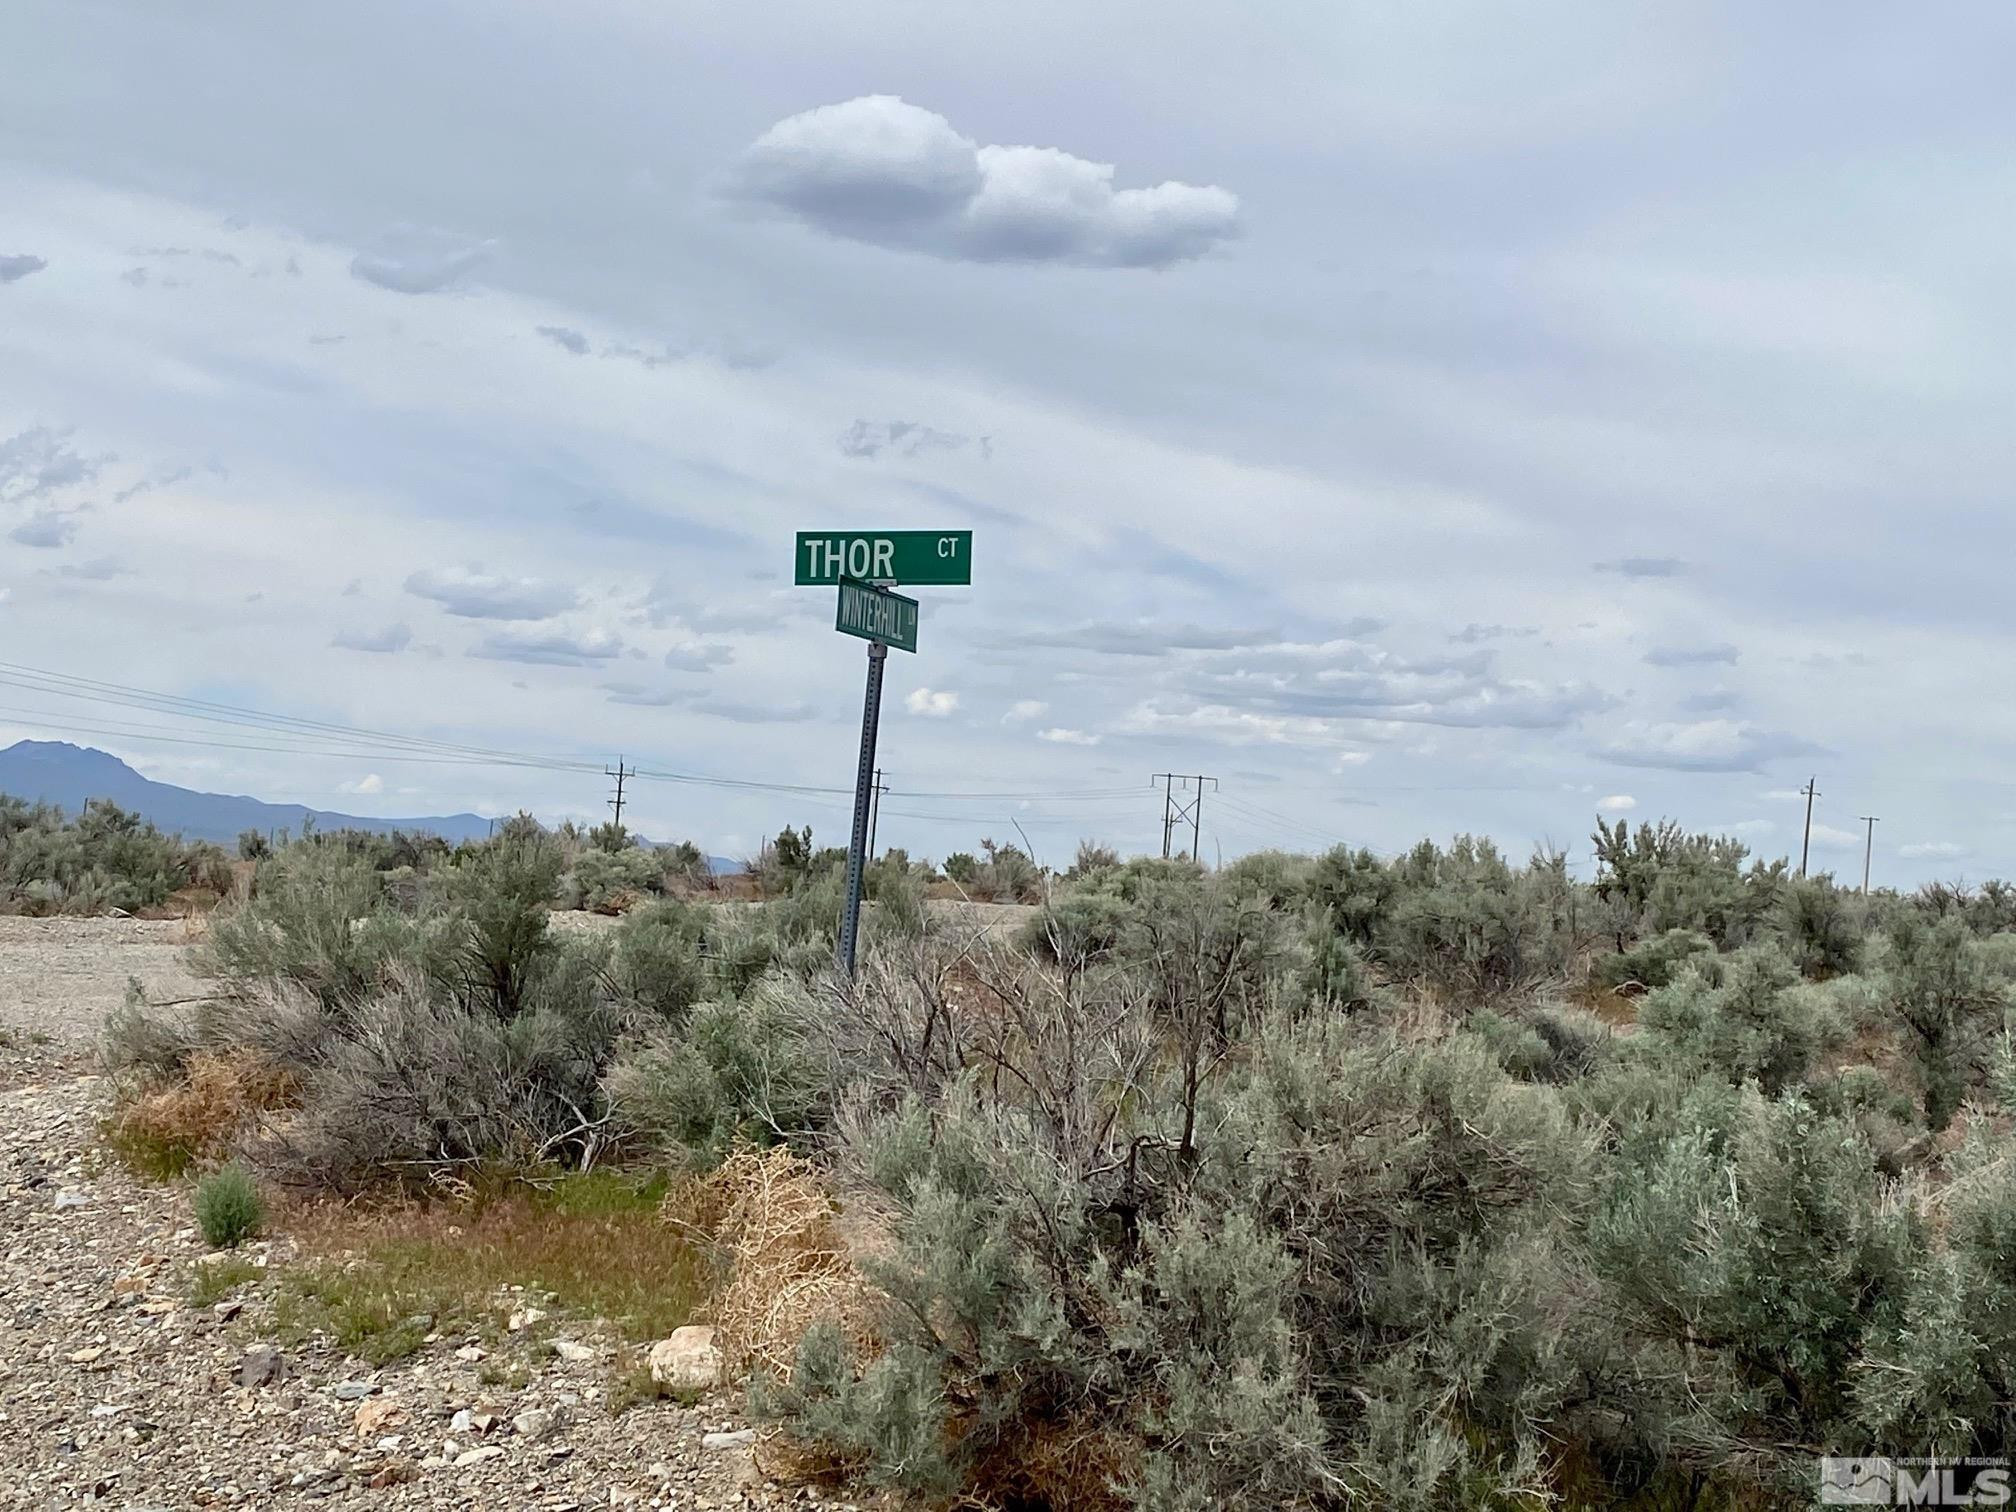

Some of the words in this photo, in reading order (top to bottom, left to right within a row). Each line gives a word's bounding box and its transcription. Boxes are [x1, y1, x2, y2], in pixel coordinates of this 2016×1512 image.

[804, 538, 895, 578] THOR
[937, 537, 959, 558] CT
[842, 584, 904, 641] WINTERHILL
